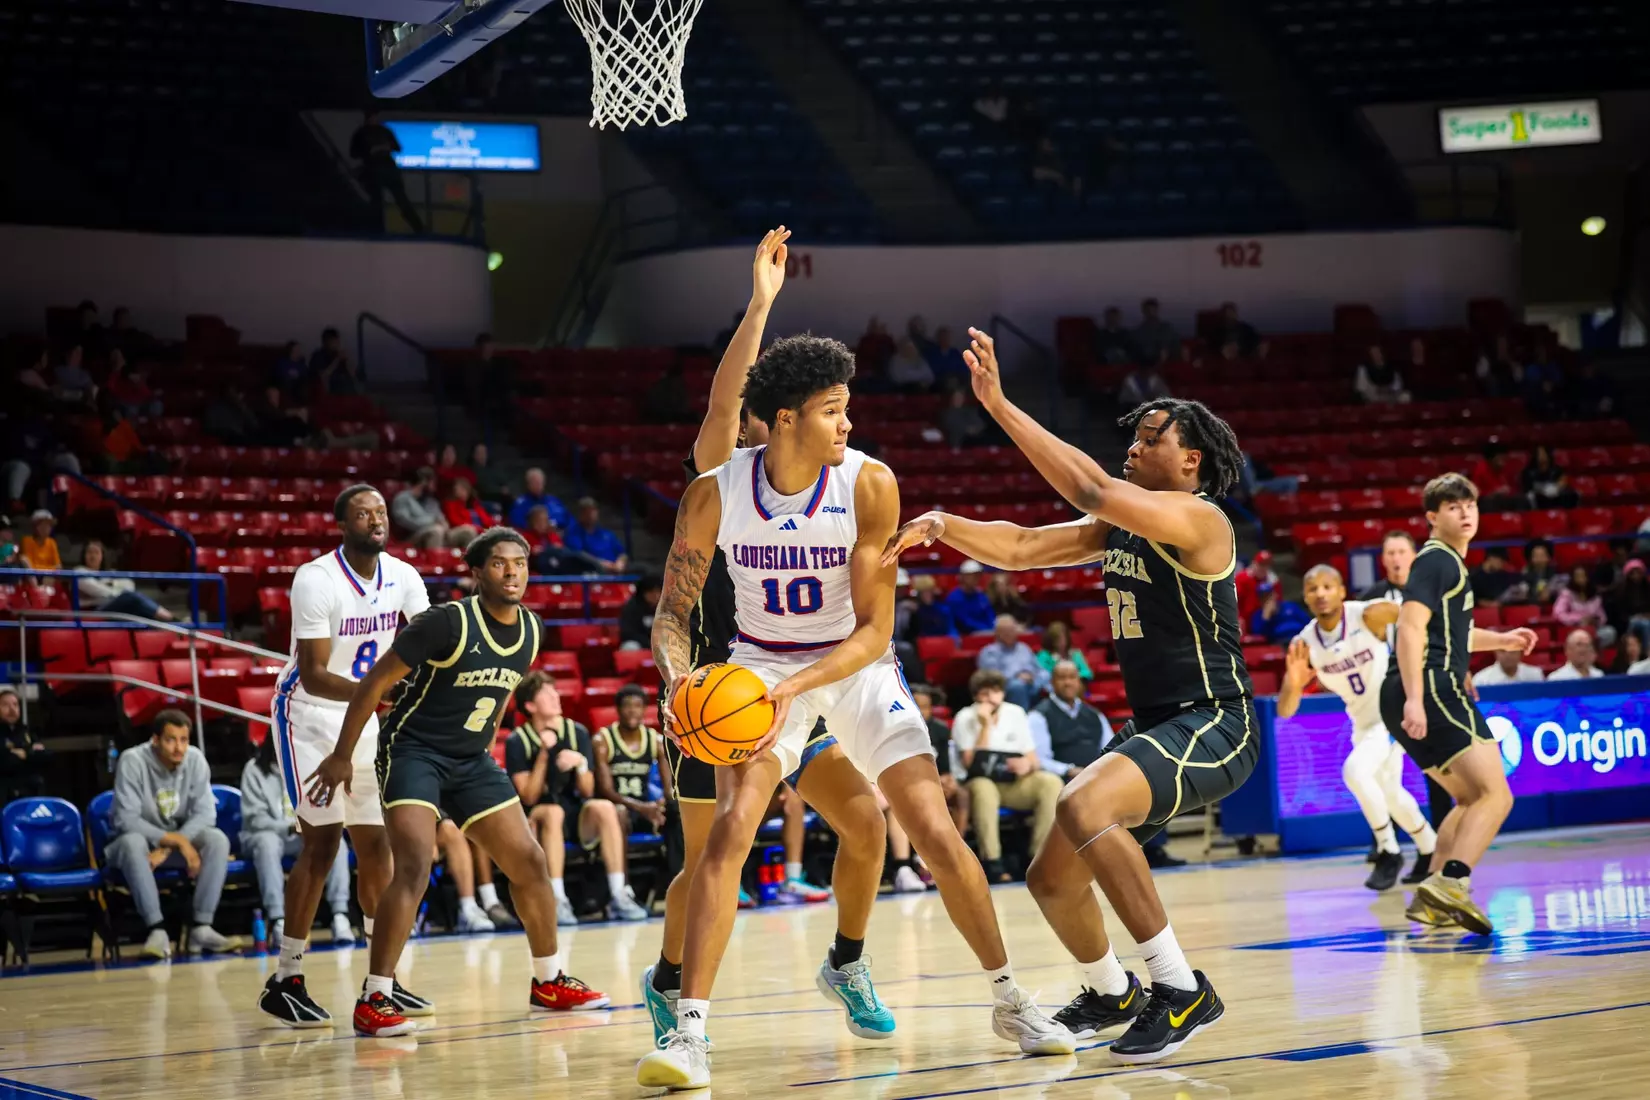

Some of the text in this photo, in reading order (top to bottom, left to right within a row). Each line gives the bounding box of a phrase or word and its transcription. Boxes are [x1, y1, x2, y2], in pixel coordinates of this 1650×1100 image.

[1449, 109, 1590, 143] Super 1 Foods
[1216, 241, 1262, 268] 102
[733, 544, 847, 570] LOUISIANA TECH
[762, 576, 823, 616] 10
[1106, 588, 1144, 639] 32
[351, 640, 378, 679] 8
[1347, 673, 1366, 695] 0
[463, 697, 496, 732] 2
[1532, 717, 1647, 773] Origin
